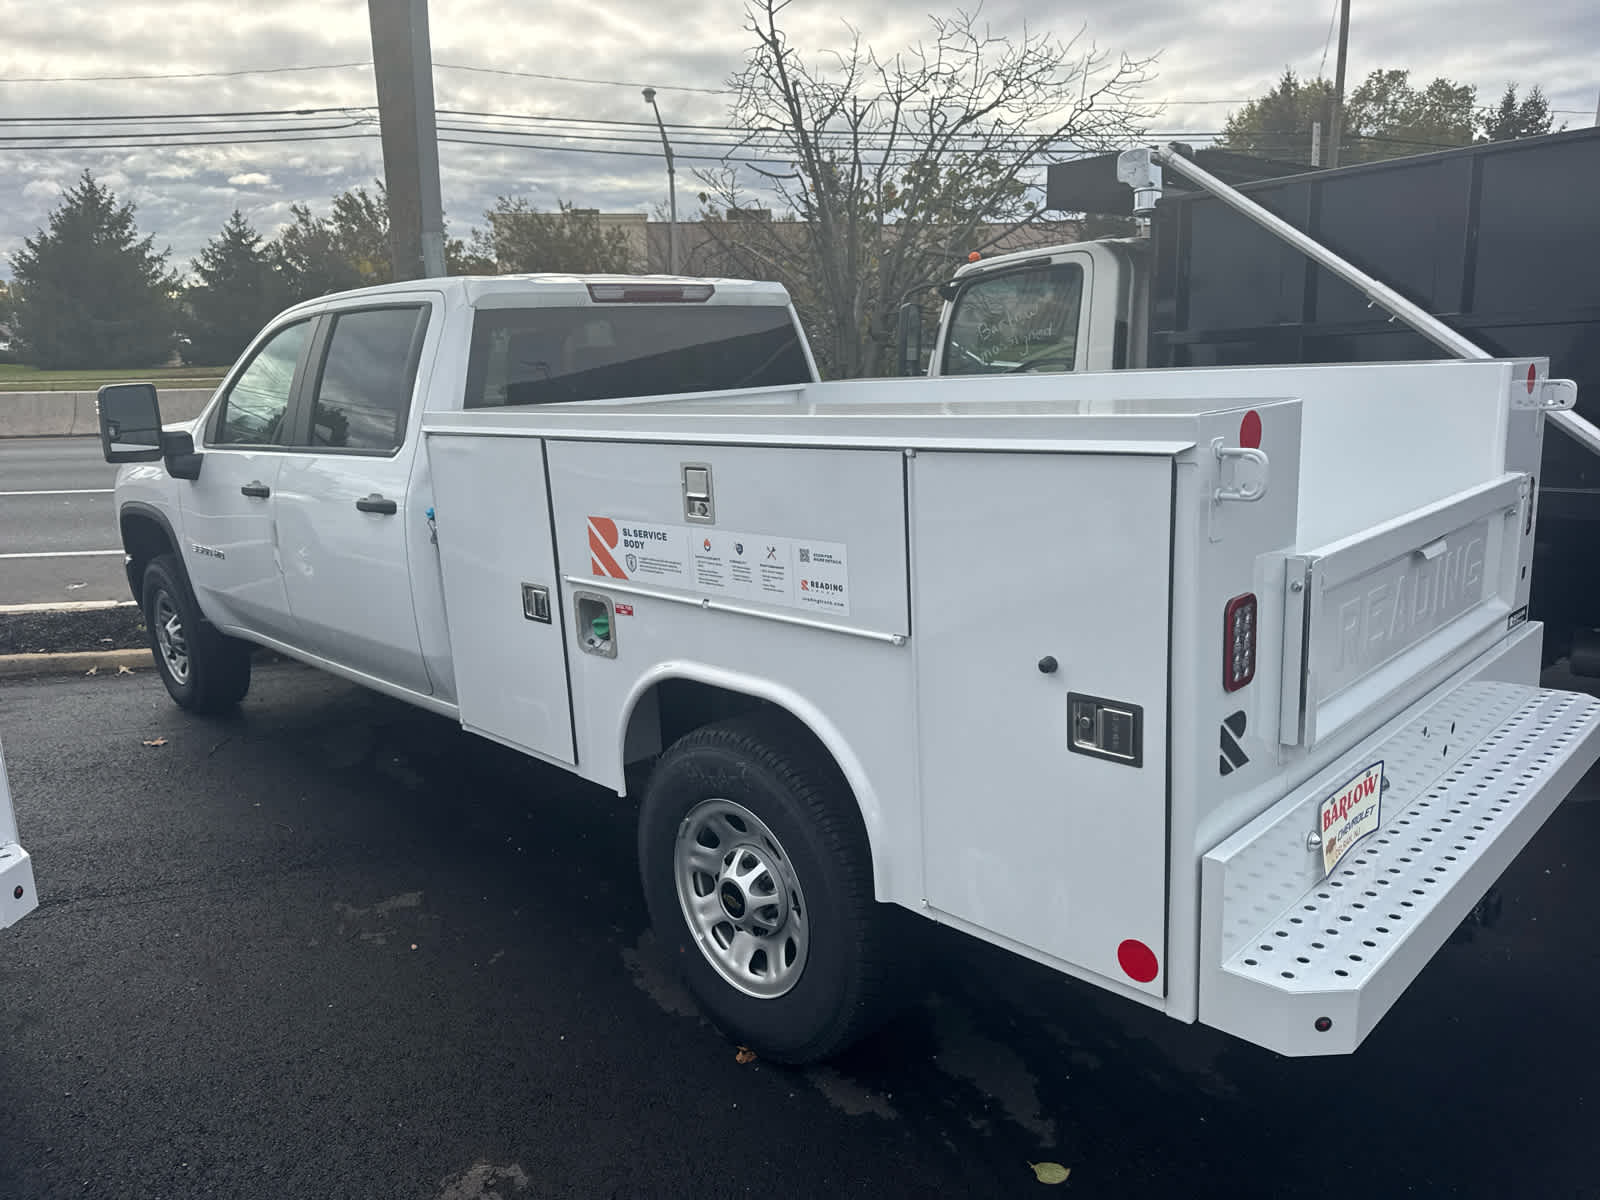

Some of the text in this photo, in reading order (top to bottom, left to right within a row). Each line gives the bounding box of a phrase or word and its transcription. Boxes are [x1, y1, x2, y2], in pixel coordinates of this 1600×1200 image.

[622, 528, 668, 541] SL SERVICE
[623, 539, 645, 549] BODY
[810, 580, 844, 592] READING
[1335, 537, 1483, 673] READING
[1323, 774, 1379, 832] BARLOW
[1337, 804, 1377, 842] CHEVROLET
